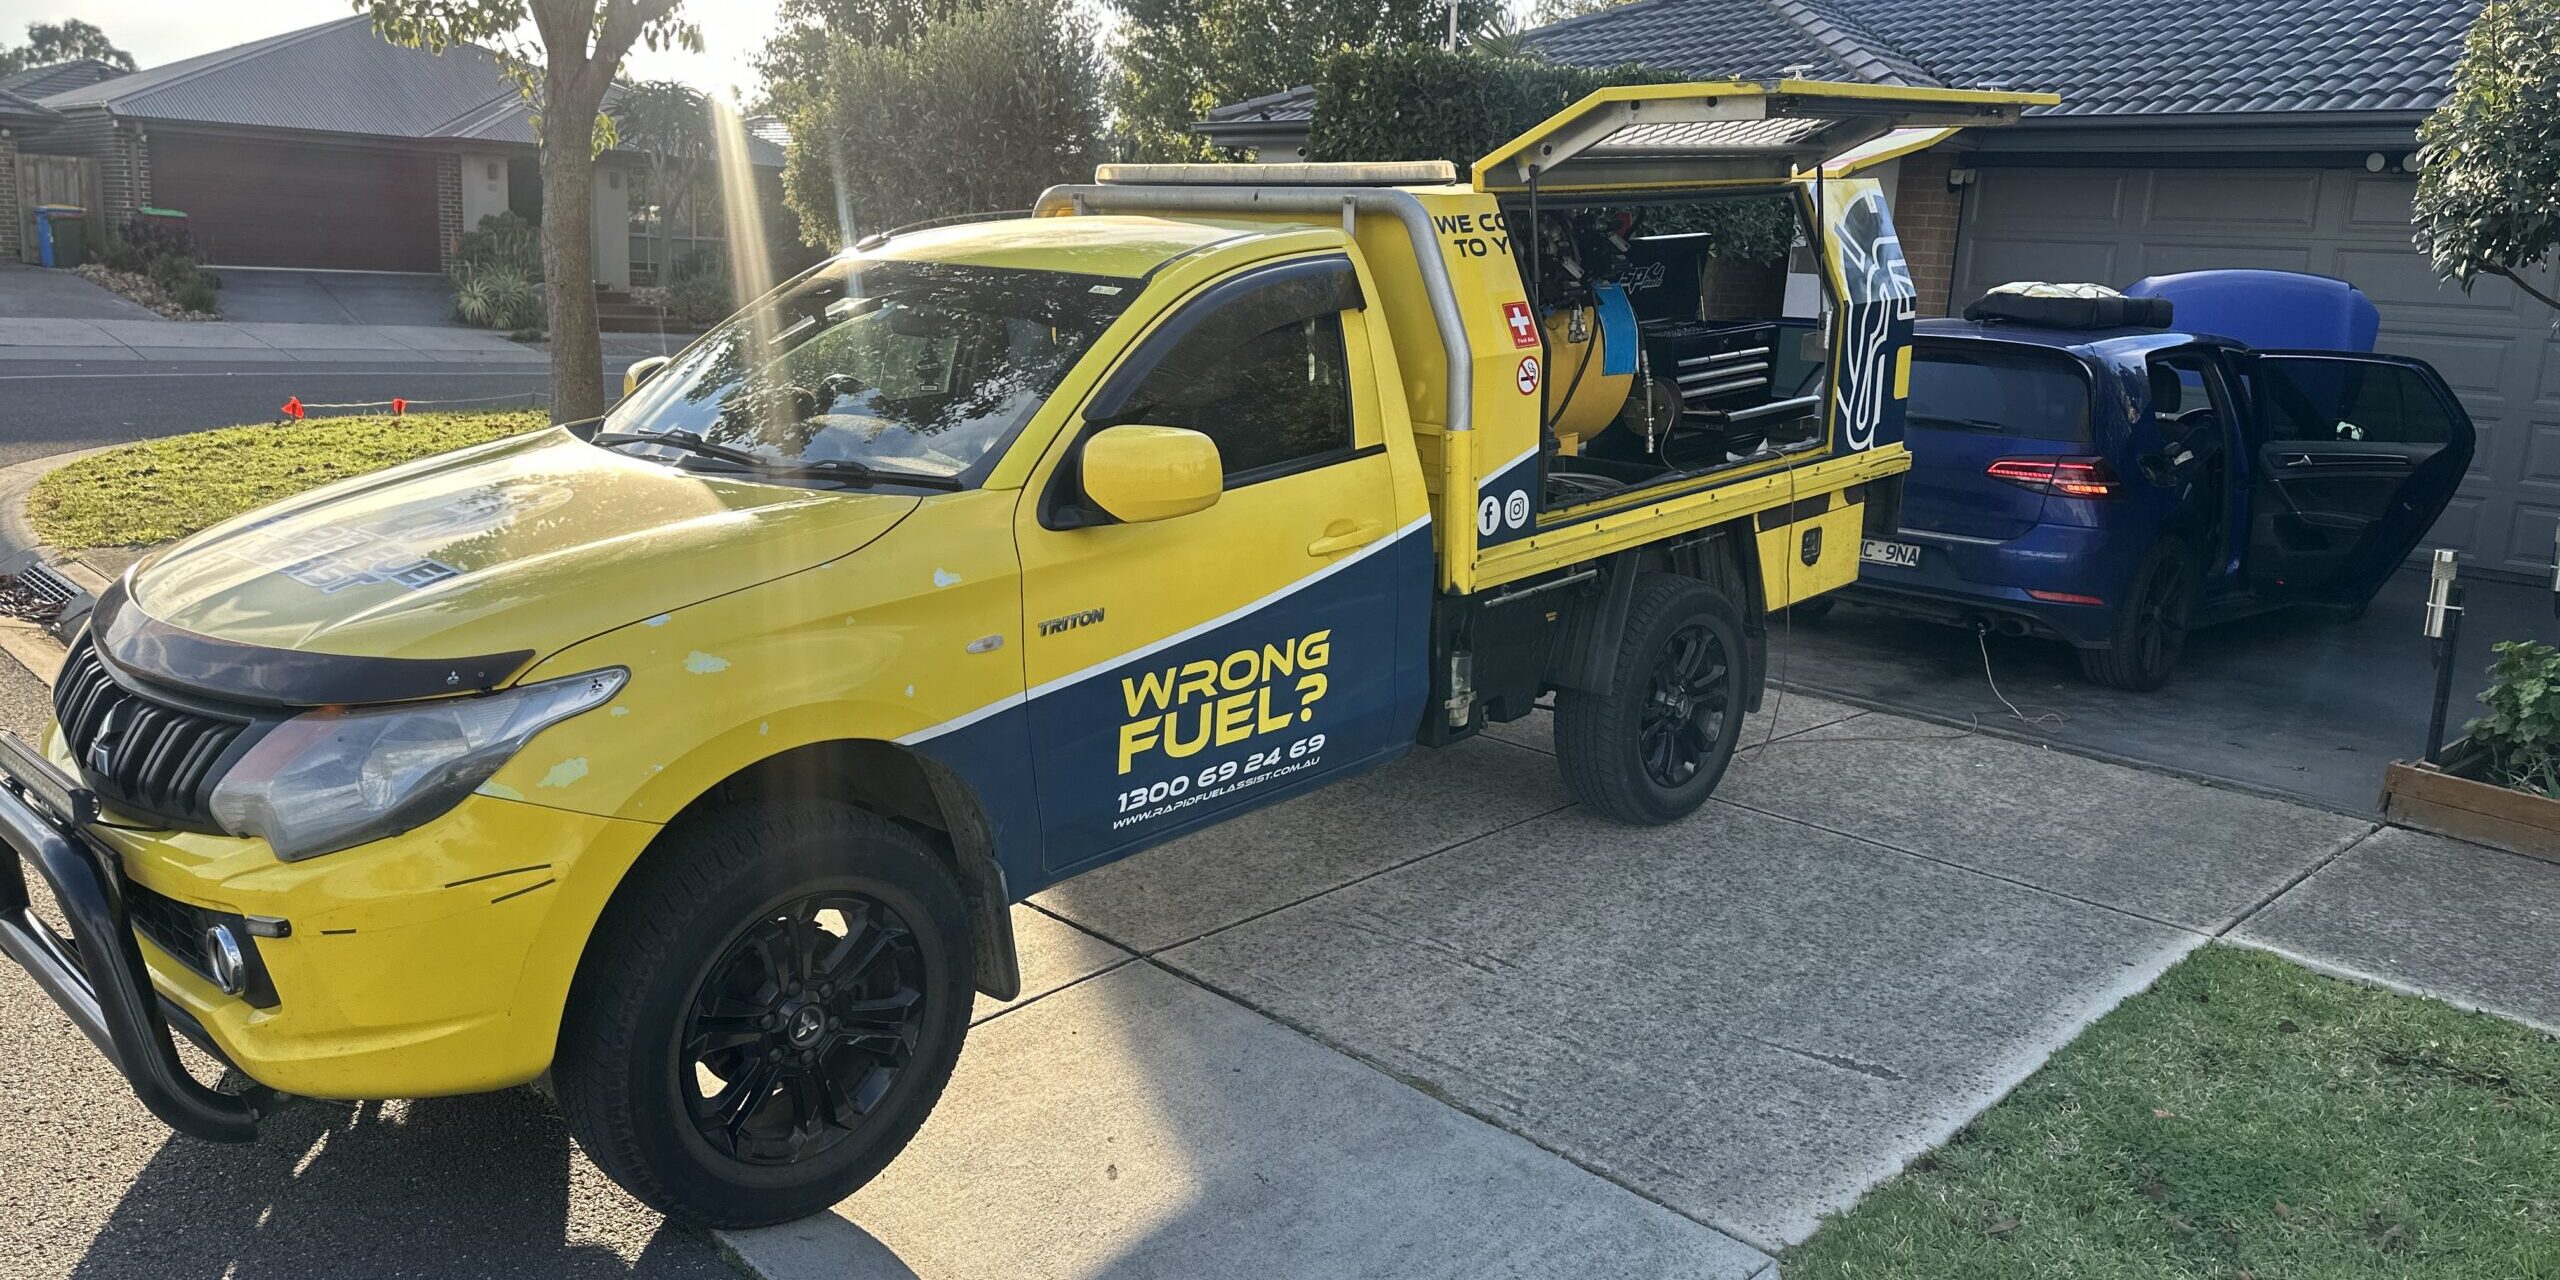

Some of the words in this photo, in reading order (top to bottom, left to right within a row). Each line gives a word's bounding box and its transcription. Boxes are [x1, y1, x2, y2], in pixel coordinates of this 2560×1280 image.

[1433, 214, 1474, 235] WE
[1453, 238, 1488, 258] TO
[1491, 236, 1508, 255] Y
[1038, 607, 1105, 637] TRITON
[1121, 628, 1332, 718] WRONG
[1118, 672, 1329, 776] FUEL?
[1112, 756, 1321, 830] WWW.RAPIDFUELASSIST.COM.AU
[1117, 775, 1190, 814] 1300
[1197, 761, 1238, 788] 69
[1243, 747, 1282, 774] 24
[1288, 733, 1327, 759] 69
